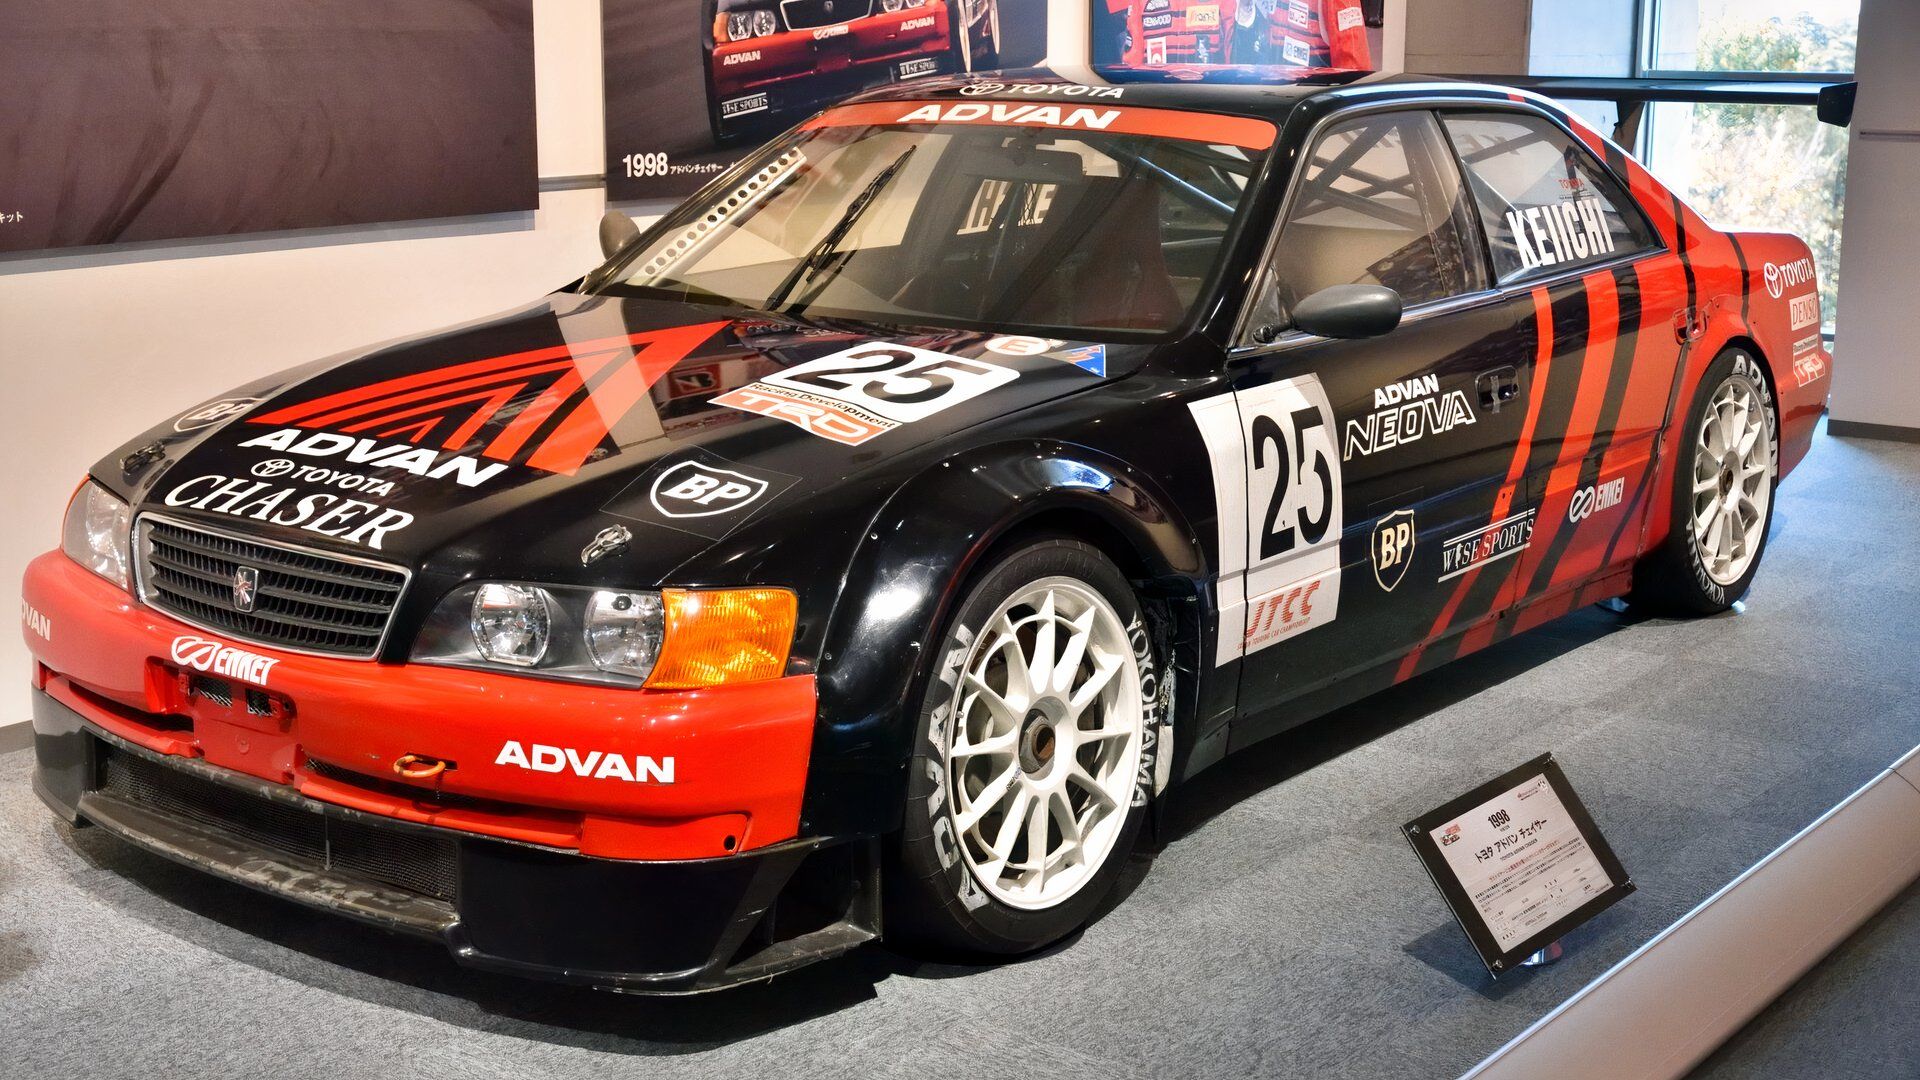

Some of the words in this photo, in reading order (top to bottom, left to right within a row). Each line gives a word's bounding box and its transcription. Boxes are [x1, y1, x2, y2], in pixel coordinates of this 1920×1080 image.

[900, 16, 935, 32] ADVAN
[723, 50, 761, 66] ADVAN
[1008, 84, 1125, 98] TOYOTA
[897, 104, 1122, 129] ADVAN
[622, 152, 669, 178] 1998
[670, 163, 724, 175] アドバンチェイサー
[1506, 198, 1615, 269] KEIICHI
[1780, 258, 1816, 288] TOYOTA
[1793, 297, 1818, 325] DENSO
[784, 349, 993, 404] 25
[1374, 374, 1440, 409] ADVAN
[737, 390, 869, 438] TRD
[750, 384, 796, 398] Racing
[797, 393, 896, 428] Development
[1343, 390, 1477, 462] NEOVA
[237, 428, 510, 488] ADVAN
[290, 465, 396, 497] TOYOTA
[660, 473, 751, 505] BP
[1251, 405, 1333, 561] 25
[1594, 477, 1625, 513] ENKEI
[164, 474, 415, 550] CHASER
[1379, 522, 1410, 570] BP
[1482, 518, 1535, 561] SPORTS
[1245, 580, 1321, 638] JTCC
[213, 647, 280, 686] ENKEI
[1125, 610, 1160, 807] YOKOHAMA
[494, 740, 675, 784] ADVAN
[1488, 808, 1511, 829] 1998
[1475, 846, 1494, 863] トヨタ
[1494, 834, 1518, 853] アドバン
[1518, 819, 1547, 839] チェイサー
